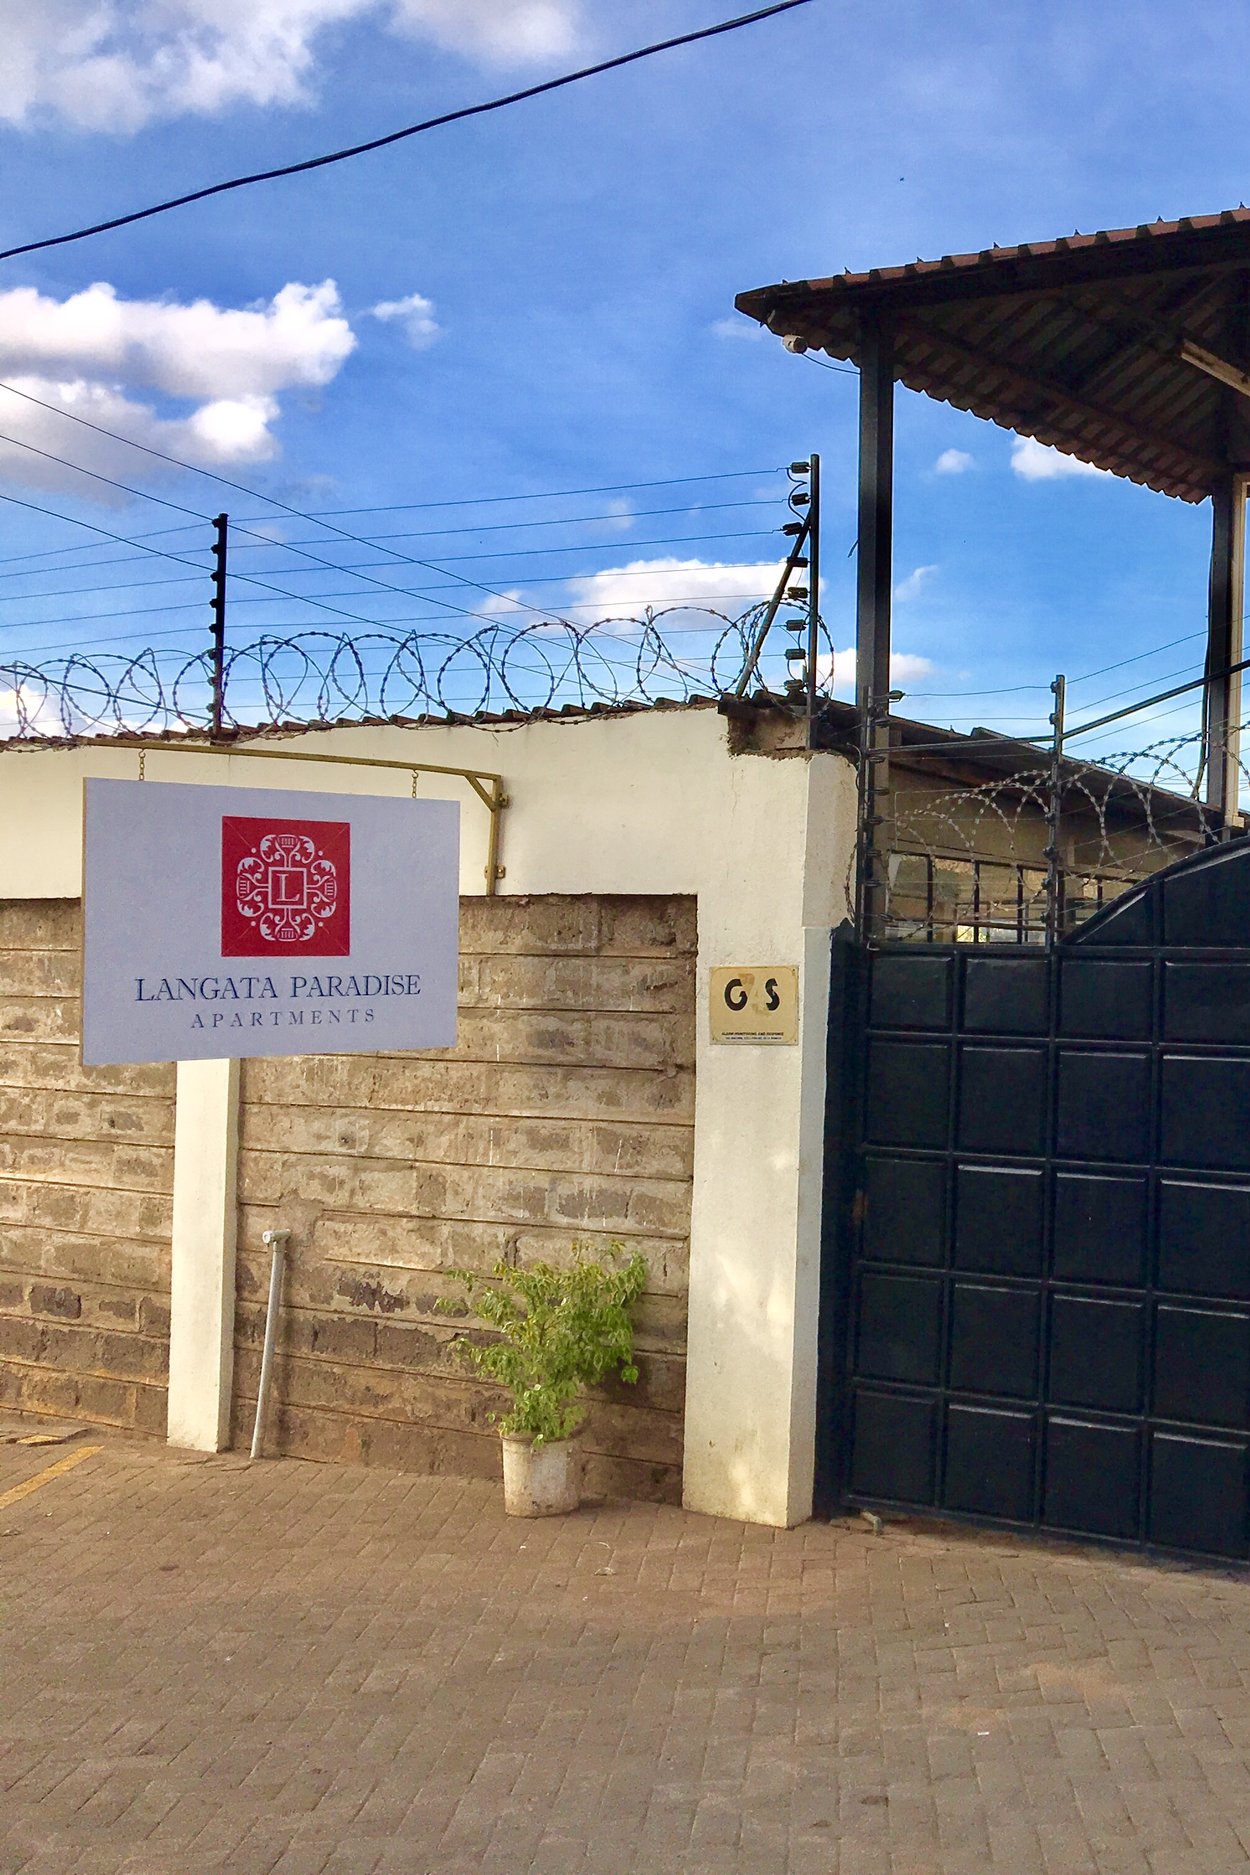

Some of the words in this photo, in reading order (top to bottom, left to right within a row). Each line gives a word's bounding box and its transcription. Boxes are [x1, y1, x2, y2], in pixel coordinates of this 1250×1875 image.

[276, 873, 299, 902] L
[135, 976, 278, 1002] LANGATA
[290, 974, 421, 998] PARADISE
[191, 1008, 376, 1029] APARTMENTS
